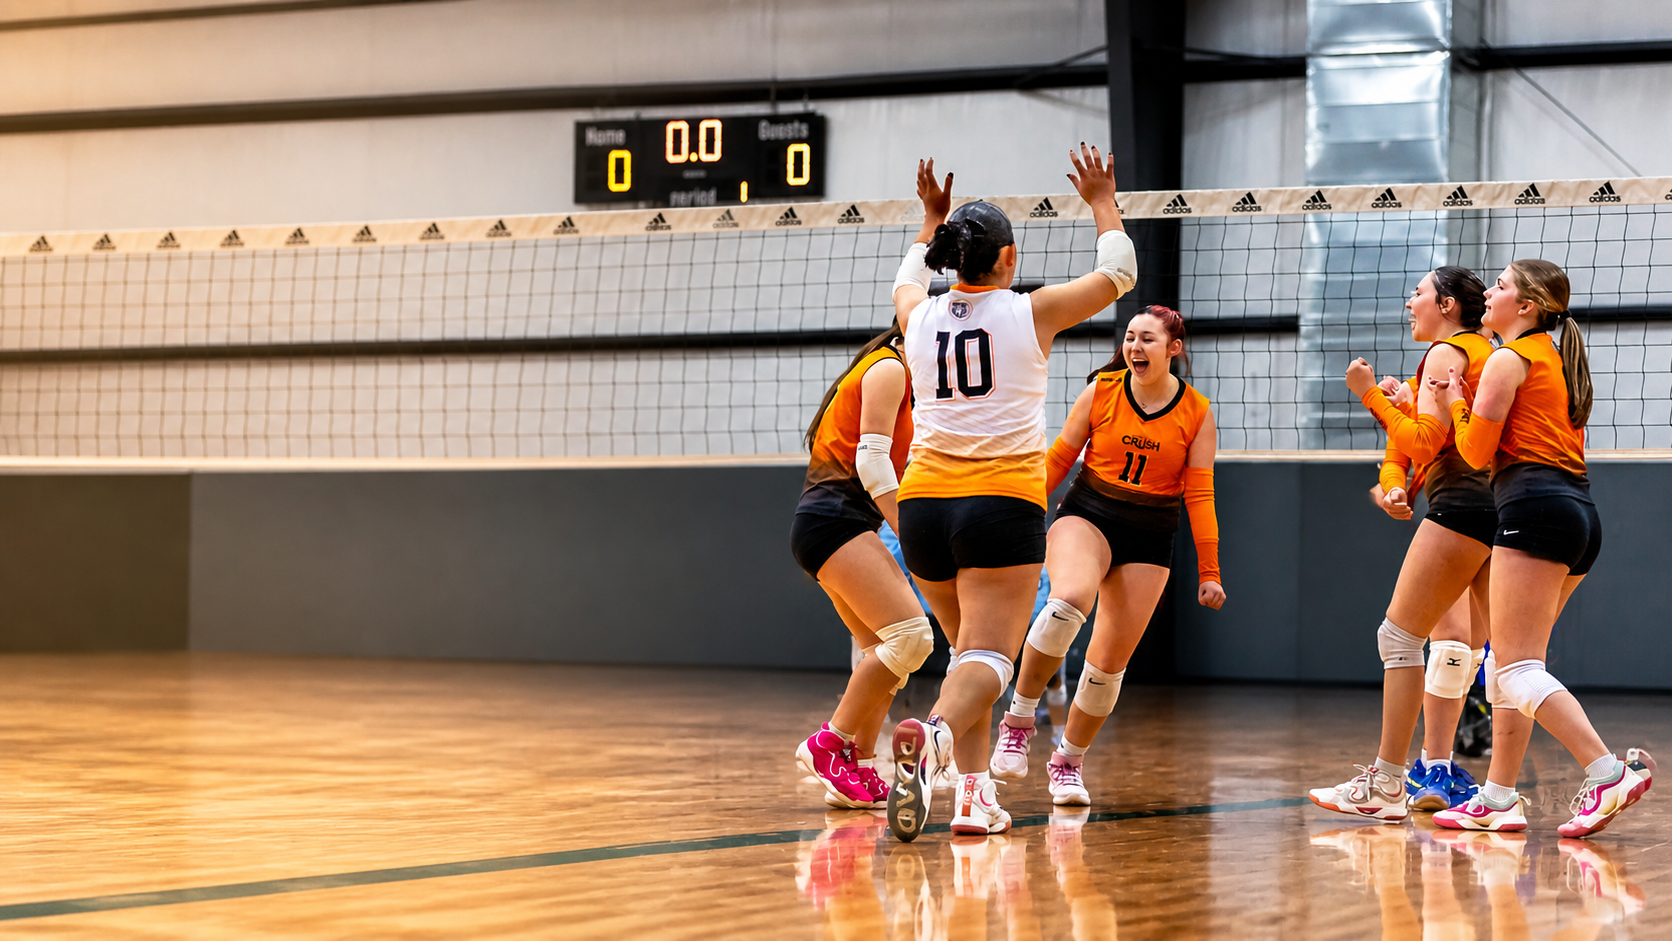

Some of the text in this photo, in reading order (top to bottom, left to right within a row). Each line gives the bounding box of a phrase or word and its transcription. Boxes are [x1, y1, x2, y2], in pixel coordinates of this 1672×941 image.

[758, 119, 809, 140] Guests
[585, 126, 626, 146] Home
[665, 118, 723, 164] 0.0
[786, 143, 811, 187] 0
[607, 149, 632, 193] 0
[1443, 198, 1473, 207] adidas
[1514, 197, 1545, 205] adidas
[1589, 195, 1621, 203] adidas
[1232, 204, 1262, 213] adidas
[1302, 202, 1332, 211] adidas
[1371, 200, 1402, 209] adidas
[1029, 210, 1058, 218] adidas
[1162, 206, 1192, 215] adidas
[775, 219, 802, 227] adidas
[837, 217, 865, 225] adidas
[935, 328, 996, 402] 10
[1121, 435, 1160, 452] CRUSH
[1118, 451, 1149, 486] 11
